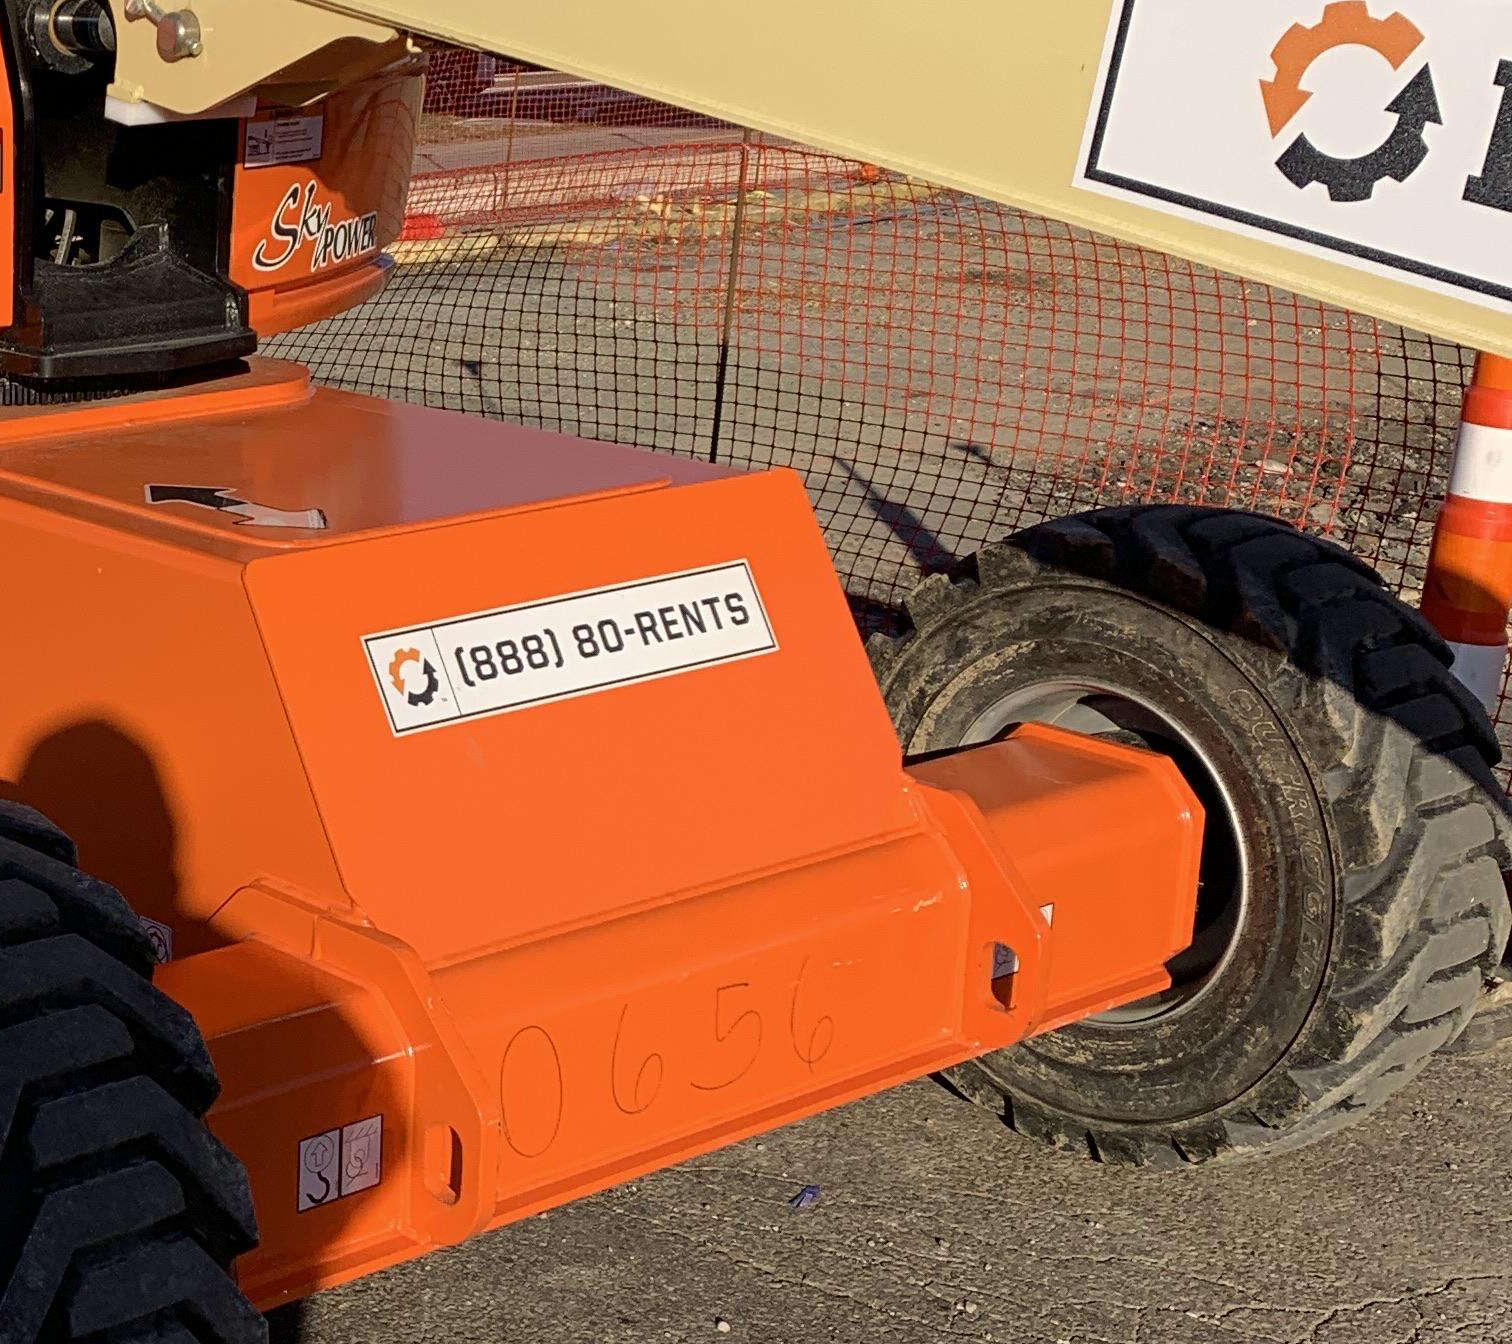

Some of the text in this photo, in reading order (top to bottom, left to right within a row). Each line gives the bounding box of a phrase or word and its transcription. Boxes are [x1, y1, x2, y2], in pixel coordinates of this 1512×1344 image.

[254, 181, 331, 271] Sky
[322, 213, 377, 263] POWER
[455, 592, 750, 687] (888) 80-RENTS
[500, 957, 834, 1158] 0656
